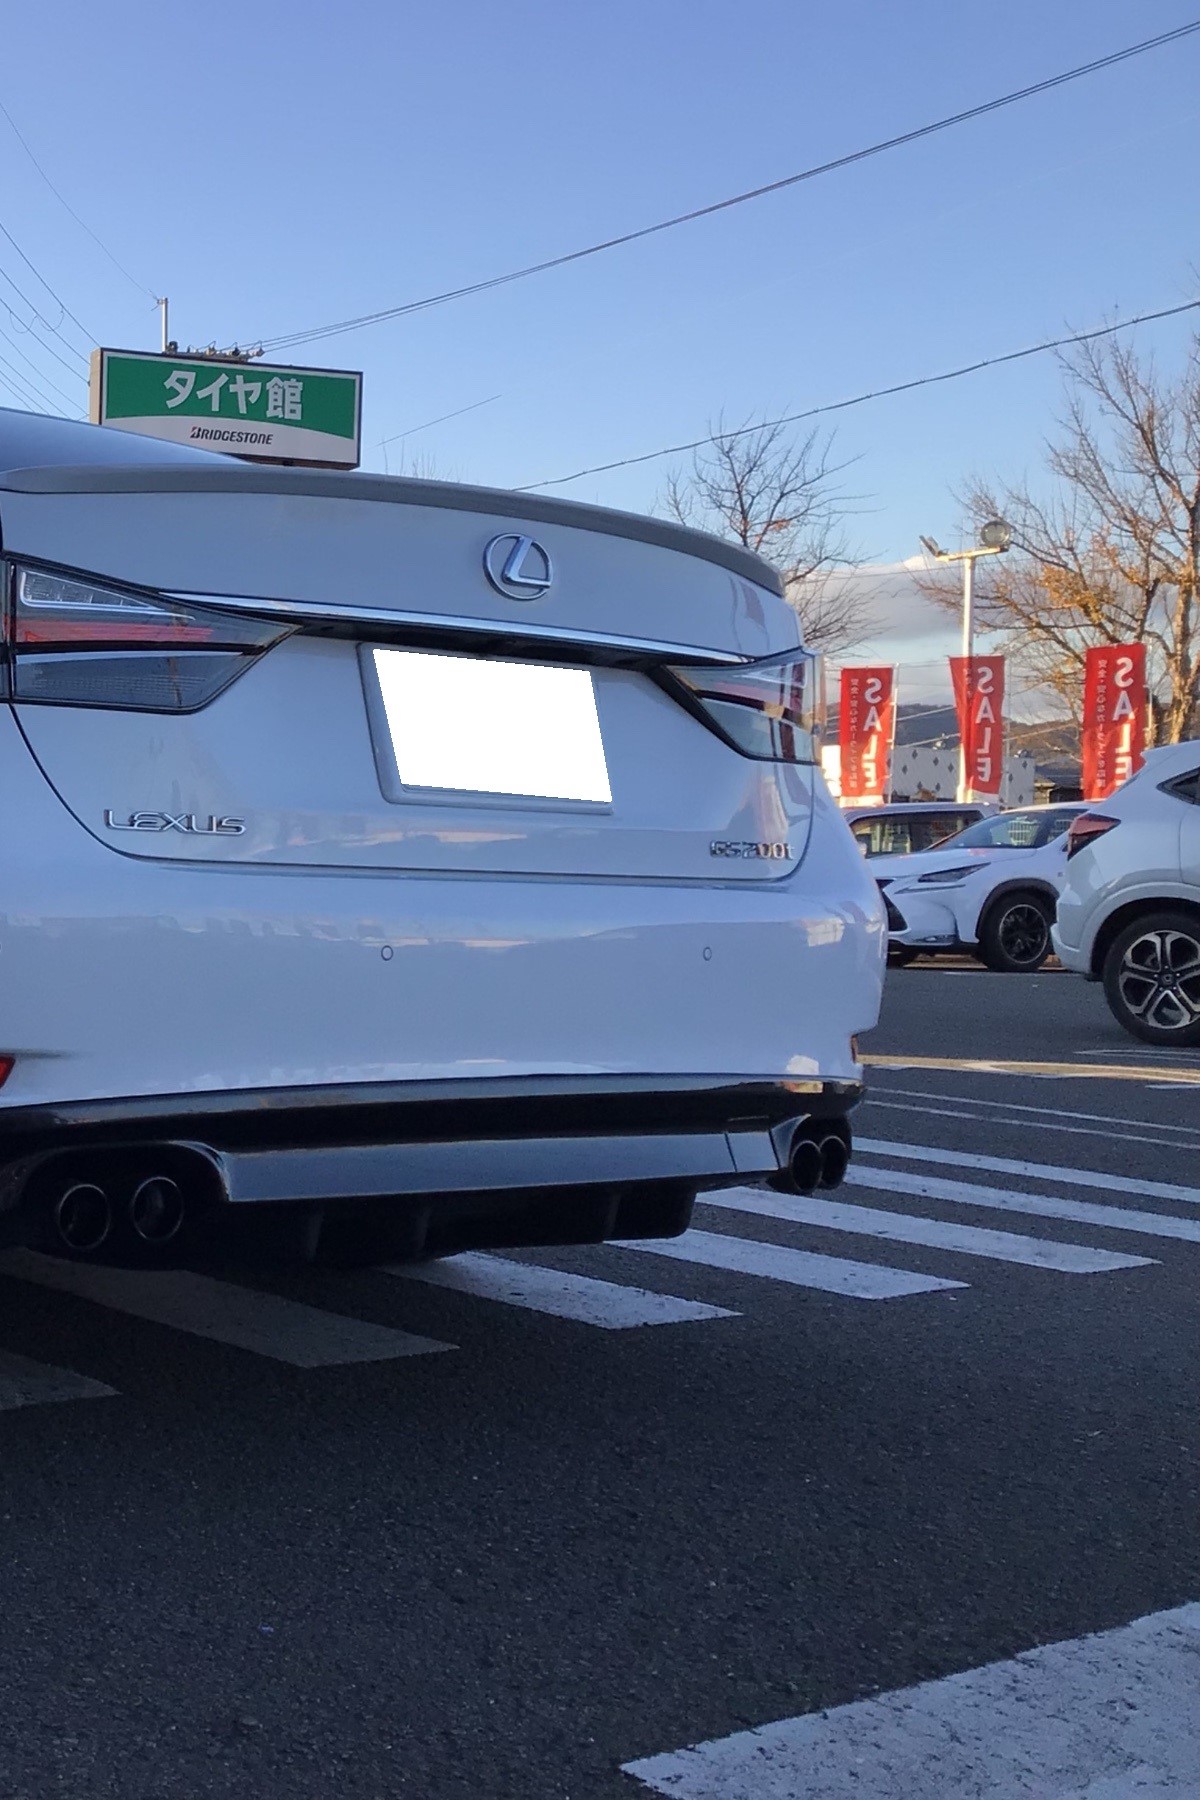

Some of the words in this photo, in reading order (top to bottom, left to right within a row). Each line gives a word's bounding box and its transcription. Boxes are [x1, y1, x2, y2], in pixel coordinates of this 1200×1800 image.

[163, 370, 303, 420] タイヤ館
[190, 426, 274, 445] BRIDGESTONE
[104, 809, 247, 836] LEXUS
